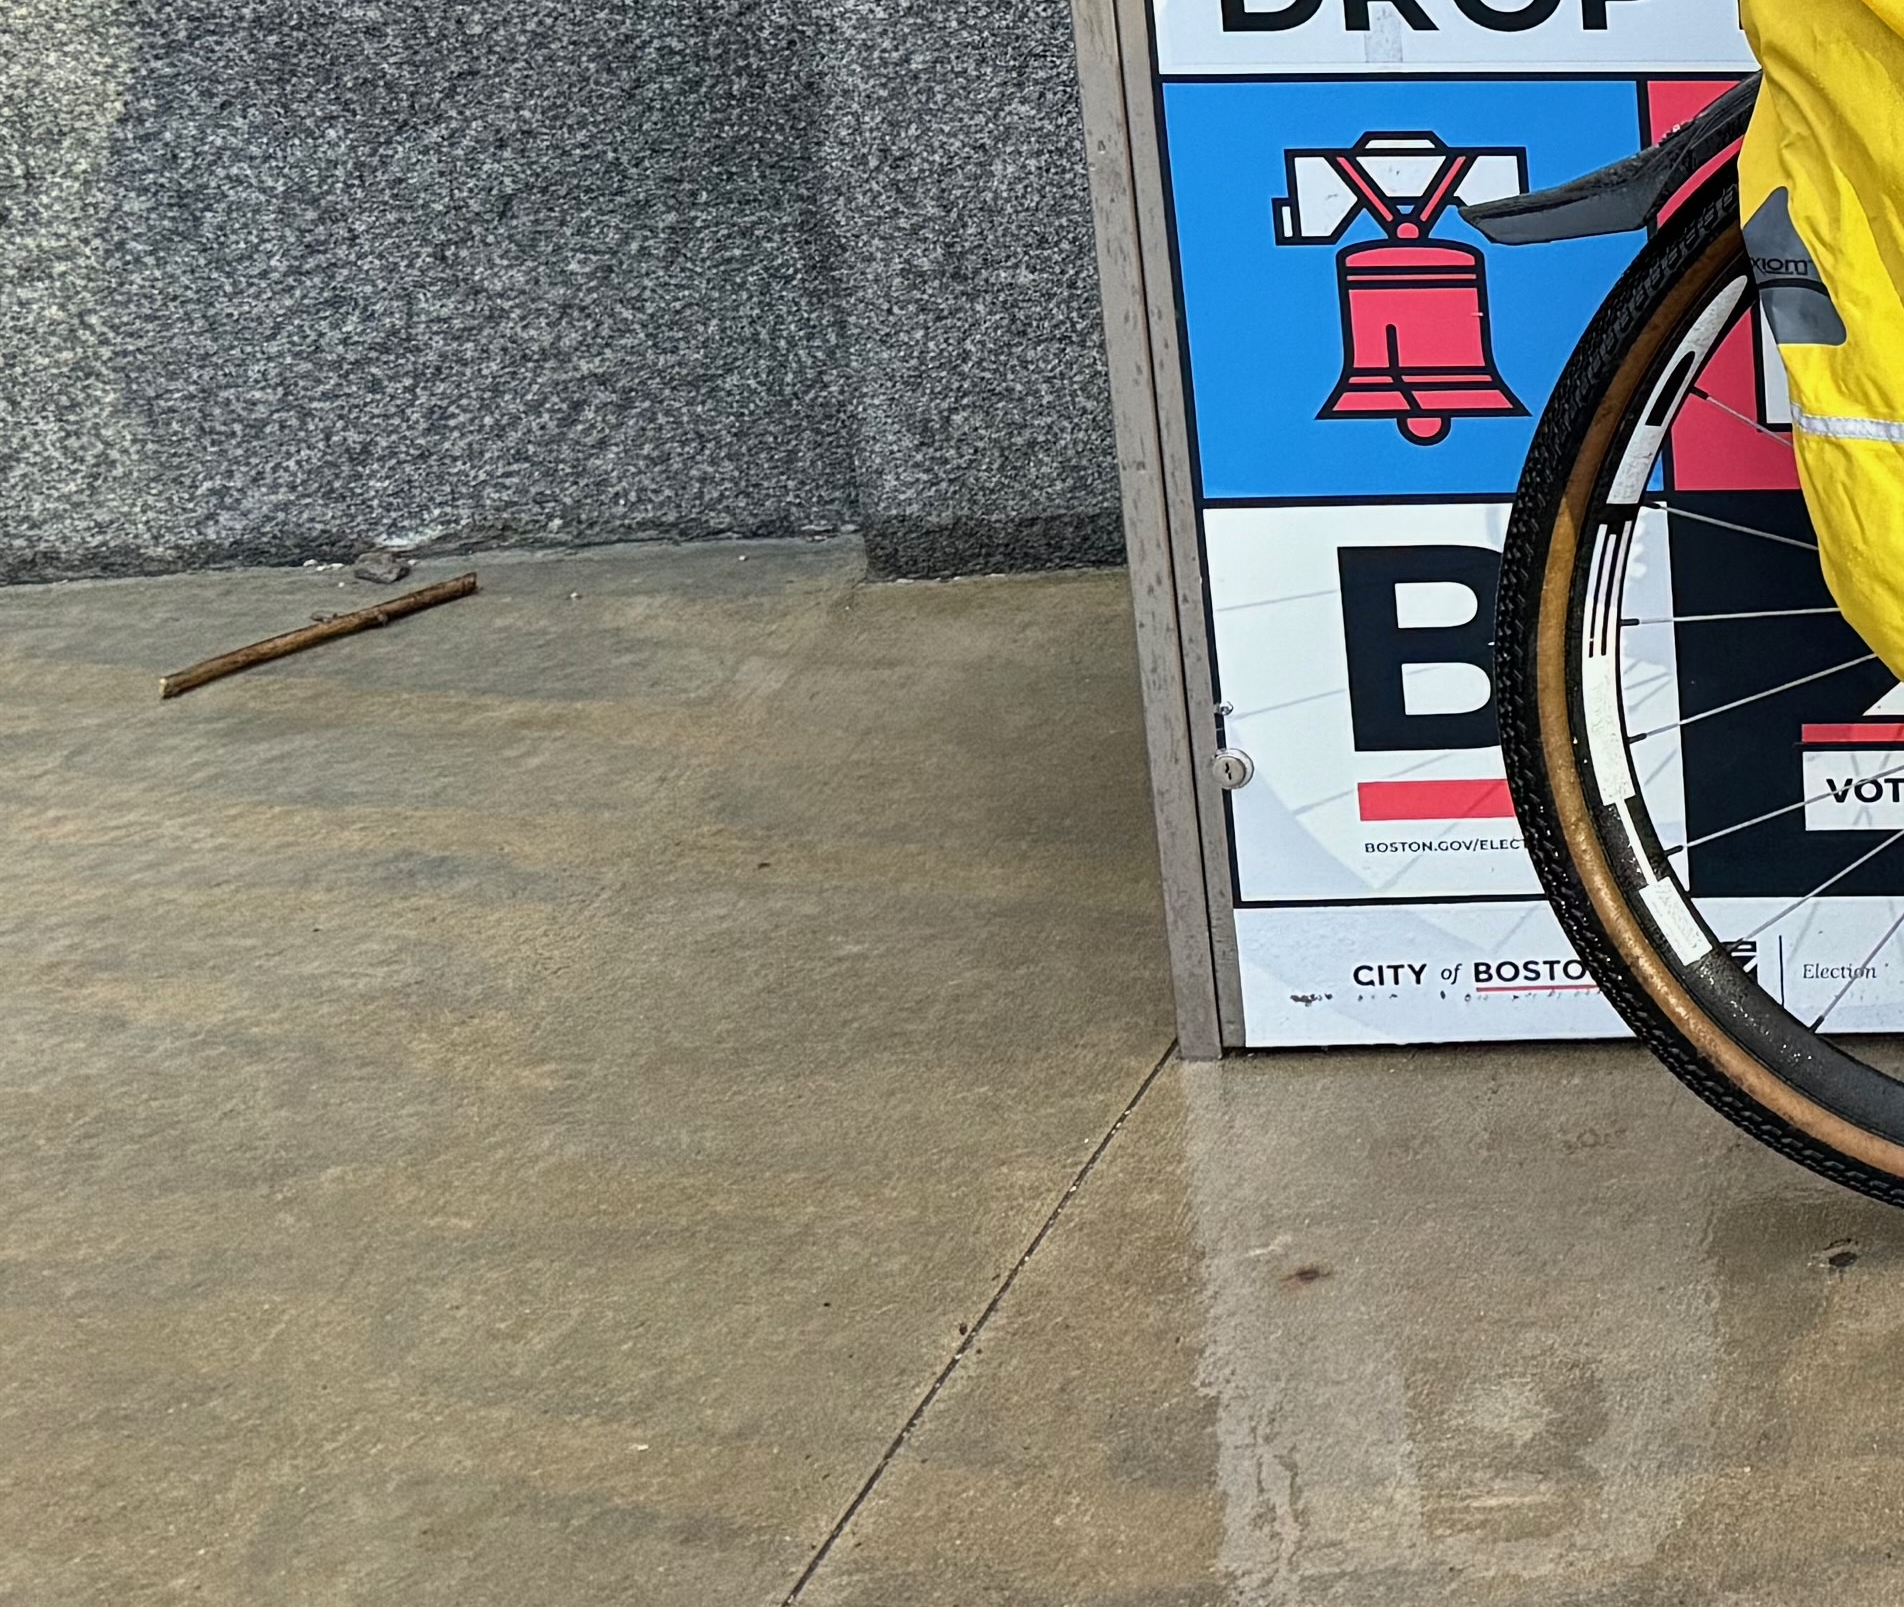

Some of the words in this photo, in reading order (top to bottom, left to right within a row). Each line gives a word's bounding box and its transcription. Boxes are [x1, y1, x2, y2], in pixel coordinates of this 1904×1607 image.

[1750, 257, 1809, 276] xiom
[1365, 838, 1527, 853] BOSTON.GOV/ELECT
[1353, 964, 1427, 986] CITY
[1440, 963, 1462, 984] of
[1474, 960, 1588, 983] BOSTO
[1803, 962, 1877, 979] Election
